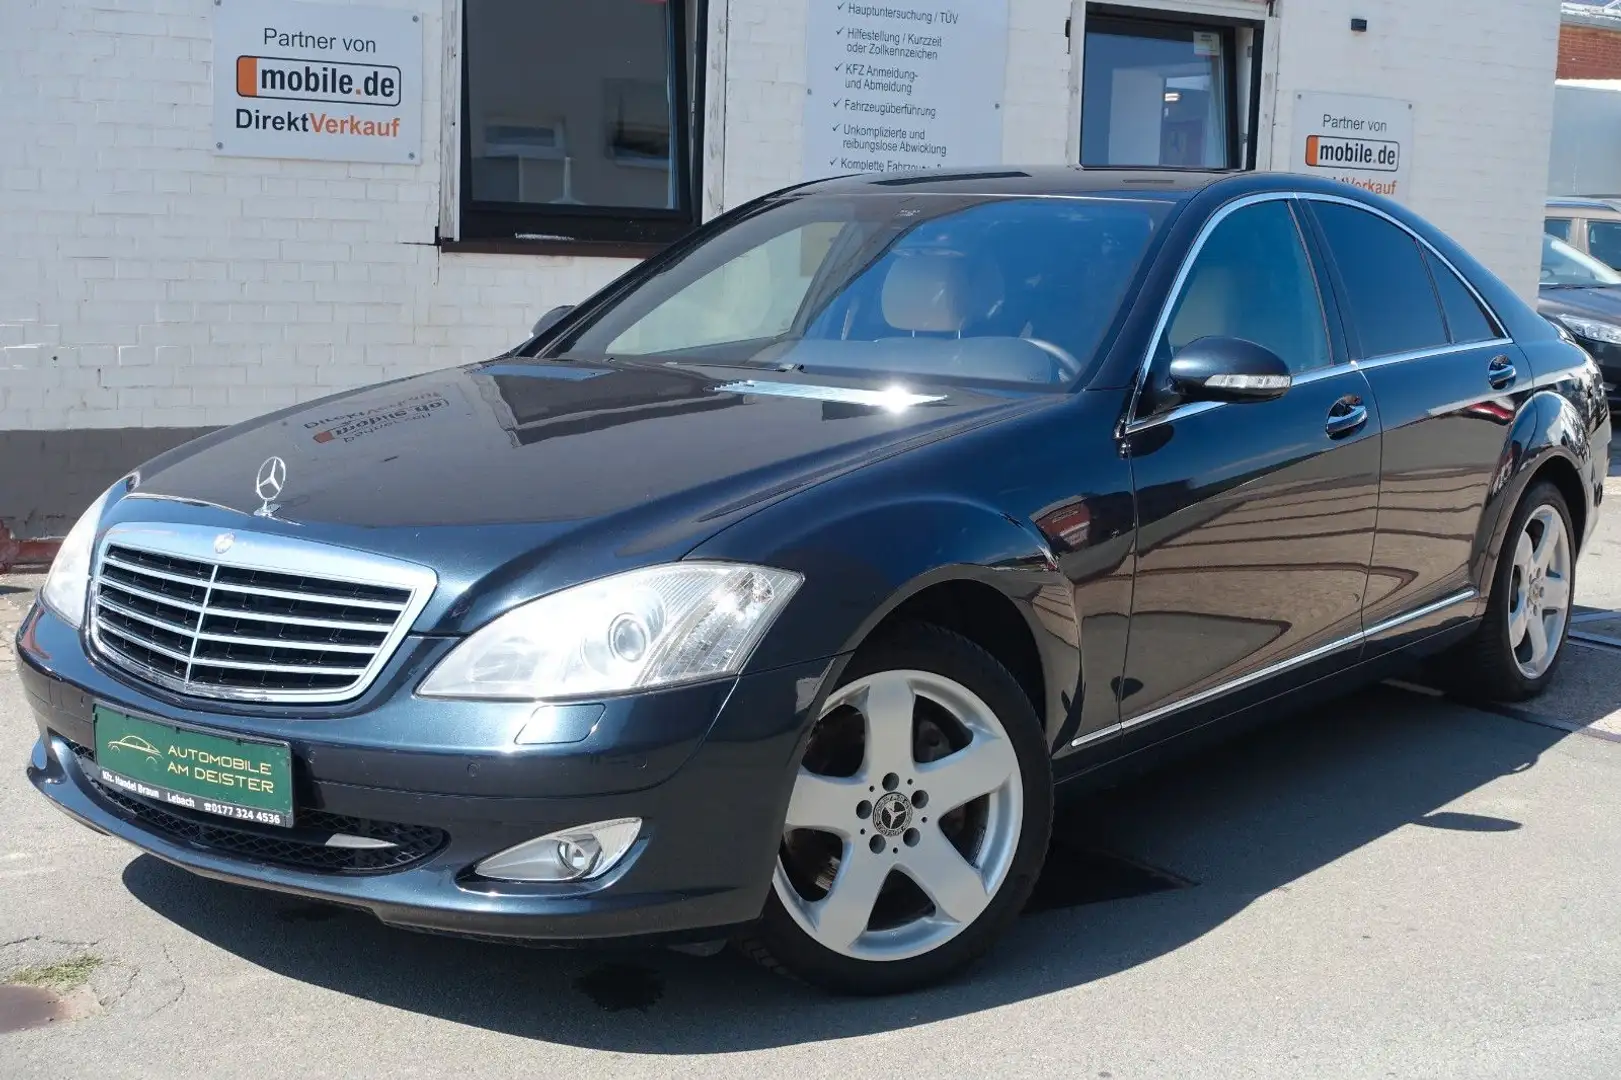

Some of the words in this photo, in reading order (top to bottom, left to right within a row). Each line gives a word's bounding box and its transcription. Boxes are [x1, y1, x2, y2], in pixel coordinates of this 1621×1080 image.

[848, 2, 932, 24] Hauptuntersuchung
[940, 9, 959, 24] TÜV
[264, 28, 336, 50] Partner
[343, 37, 376, 53] von
[847, 27, 900, 46] Hilfestellung
[907, 33, 942, 47] Kurzzeit
[846, 42, 867, 54] oder
[869, 43, 938, 60] Zollkennzeichen
[845, 64, 864, 76] KFZ
[261, 66, 395, 97] mobile.de
[845, 78, 861, 89] und
[864, 79, 912, 96] Abmeldung
[844, 99, 936, 119] Fahrzeugüberführung
[236, 108, 401, 138] DirektVerkauf
[843, 124, 907, 138] Unkomplizierte
[909, 129, 925, 140] und
[1322, 113, 1365, 130] Partner
[1368, 120, 1387, 132] von
[843, 138, 897, 153] reibungslose
[899, 141, 947, 157] Abwicklung
[1320, 142, 1396, 165] mobile.de
[840, 158, 884, 172] Komplette
[167, 744, 272, 776] AUTOMOBILE
[167, 761, 189, 777] AM
[194, 768, 274, 794] DEISTER
[115, 775, 137, 791] Handel
[137, 783, 160, 799] Braun
[167, 792, 195, 808] Lebach
[235, 807, 254, 820] 324
[256, 811, 280, 824] 4536
